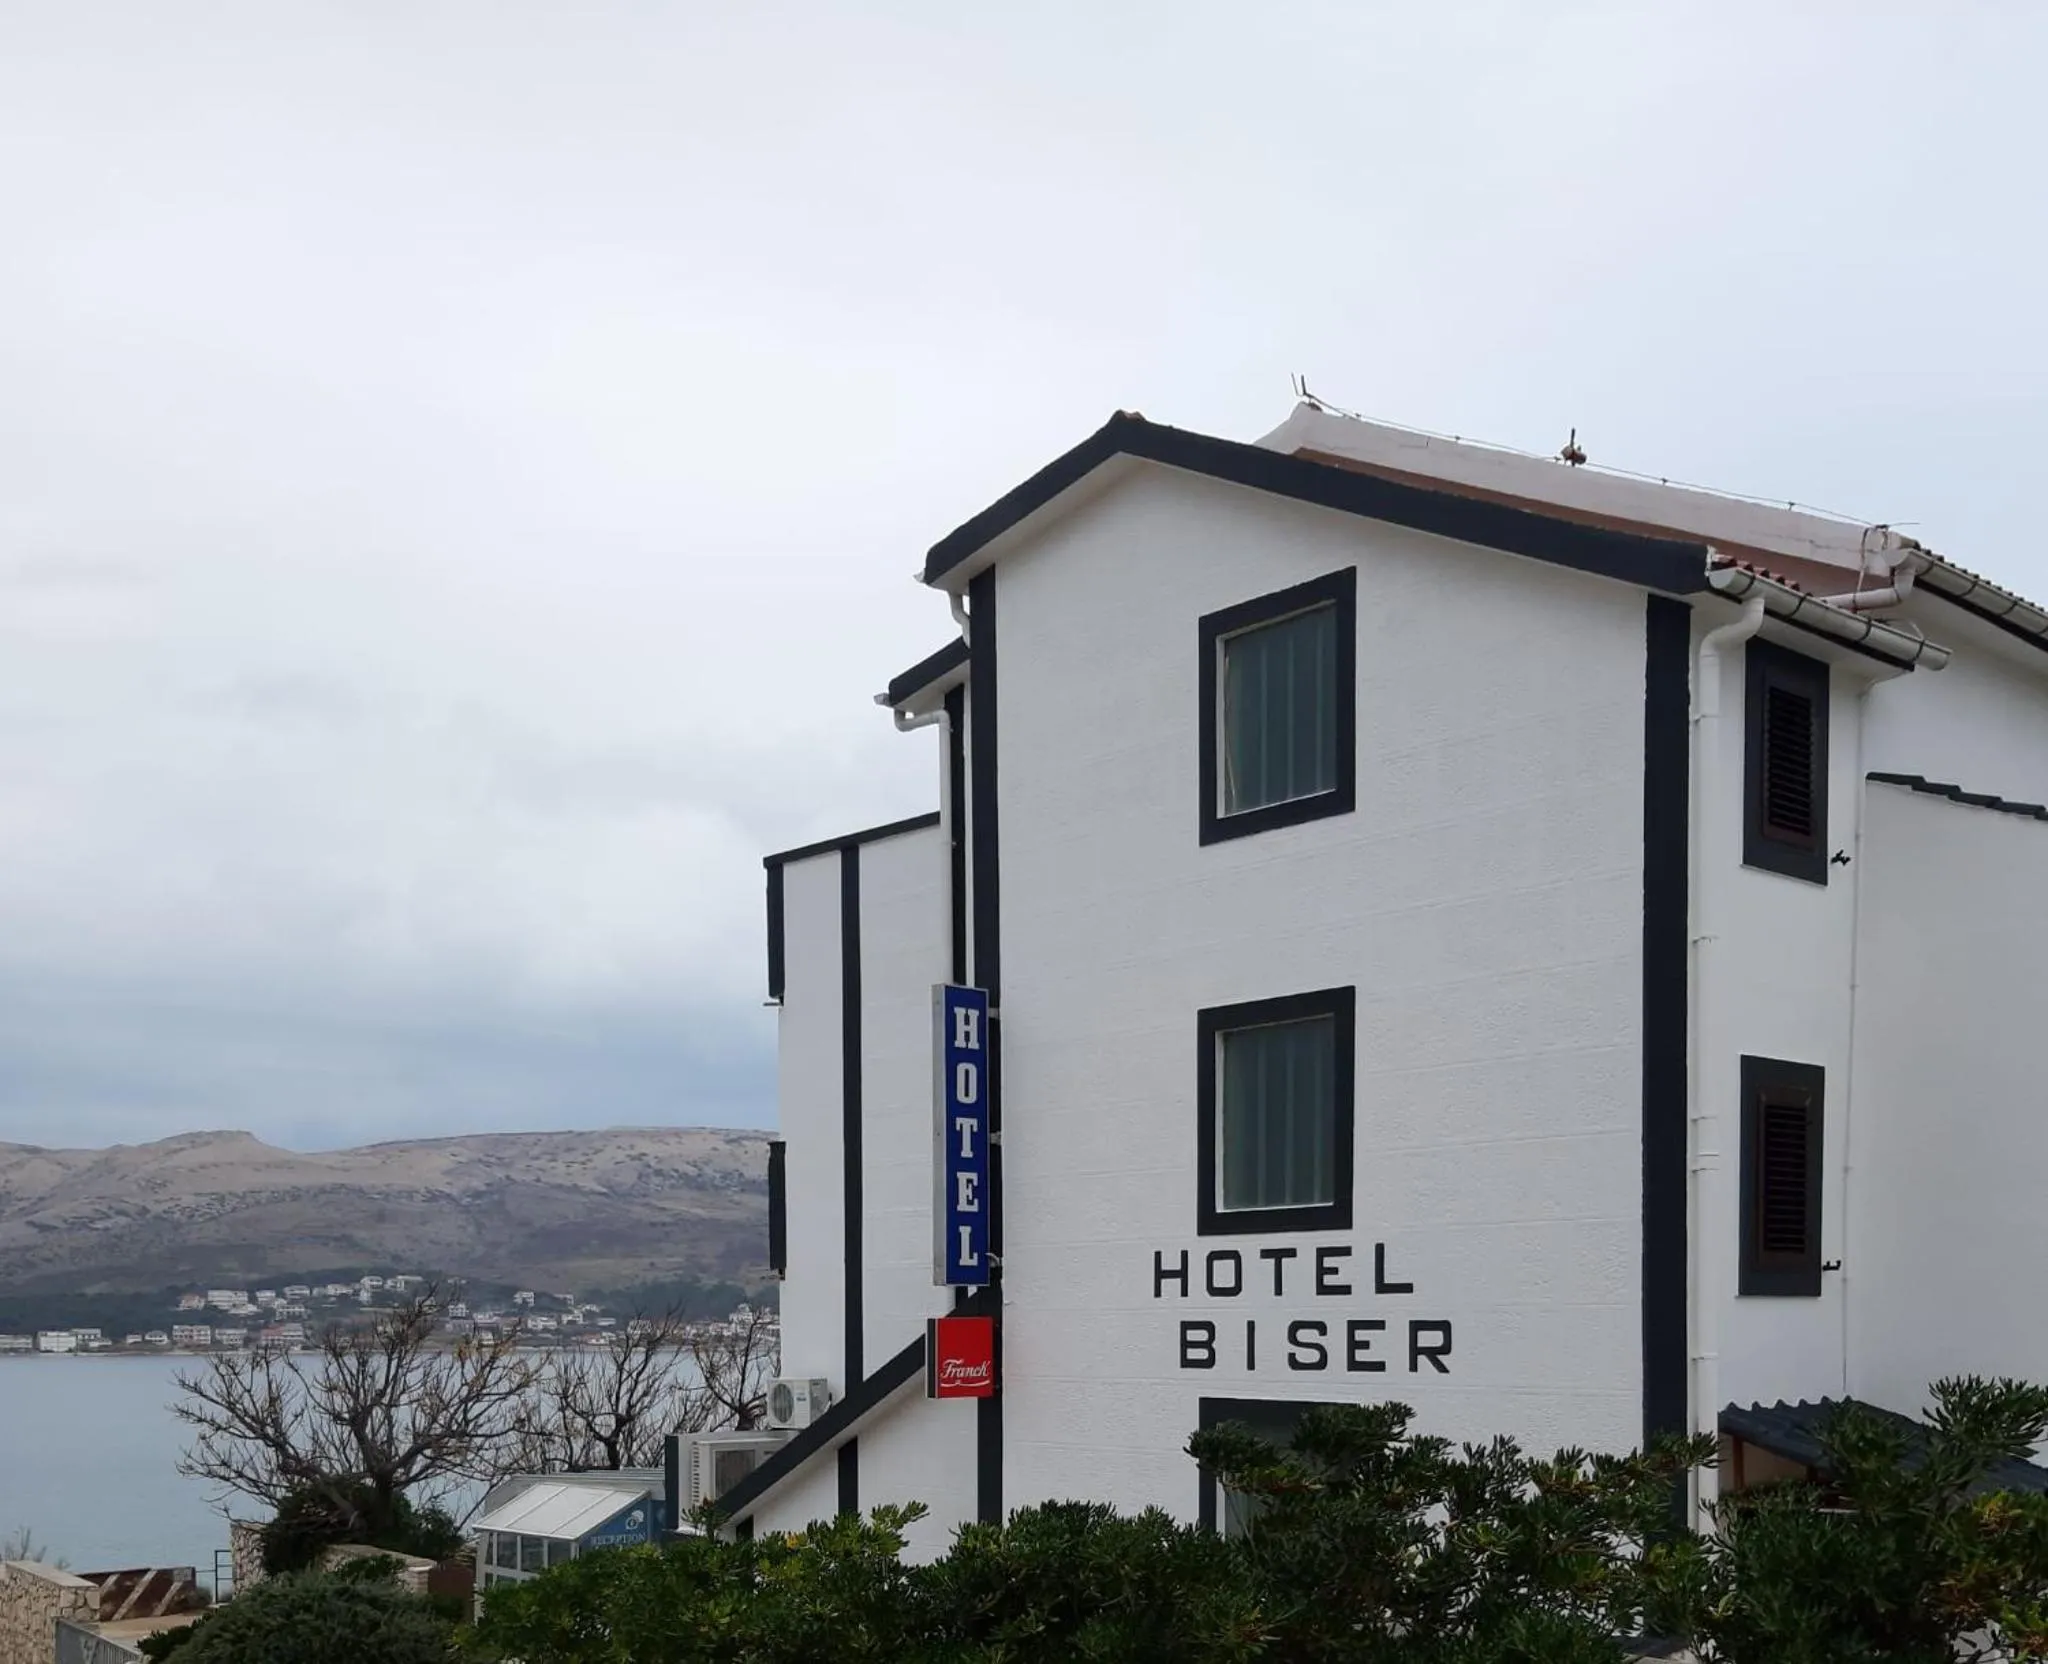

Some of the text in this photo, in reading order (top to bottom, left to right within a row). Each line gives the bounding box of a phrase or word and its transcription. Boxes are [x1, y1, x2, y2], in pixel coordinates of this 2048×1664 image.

[954, 1007, 980, 1267] HOTEL
[1153, 1243, 1414, 1298] HOTEL
[940, 1358, 991, 1378] Franck
[1180, 1319, 1453, 1374] BISER
[591, 1532, 647, 1546] RECEPTION
